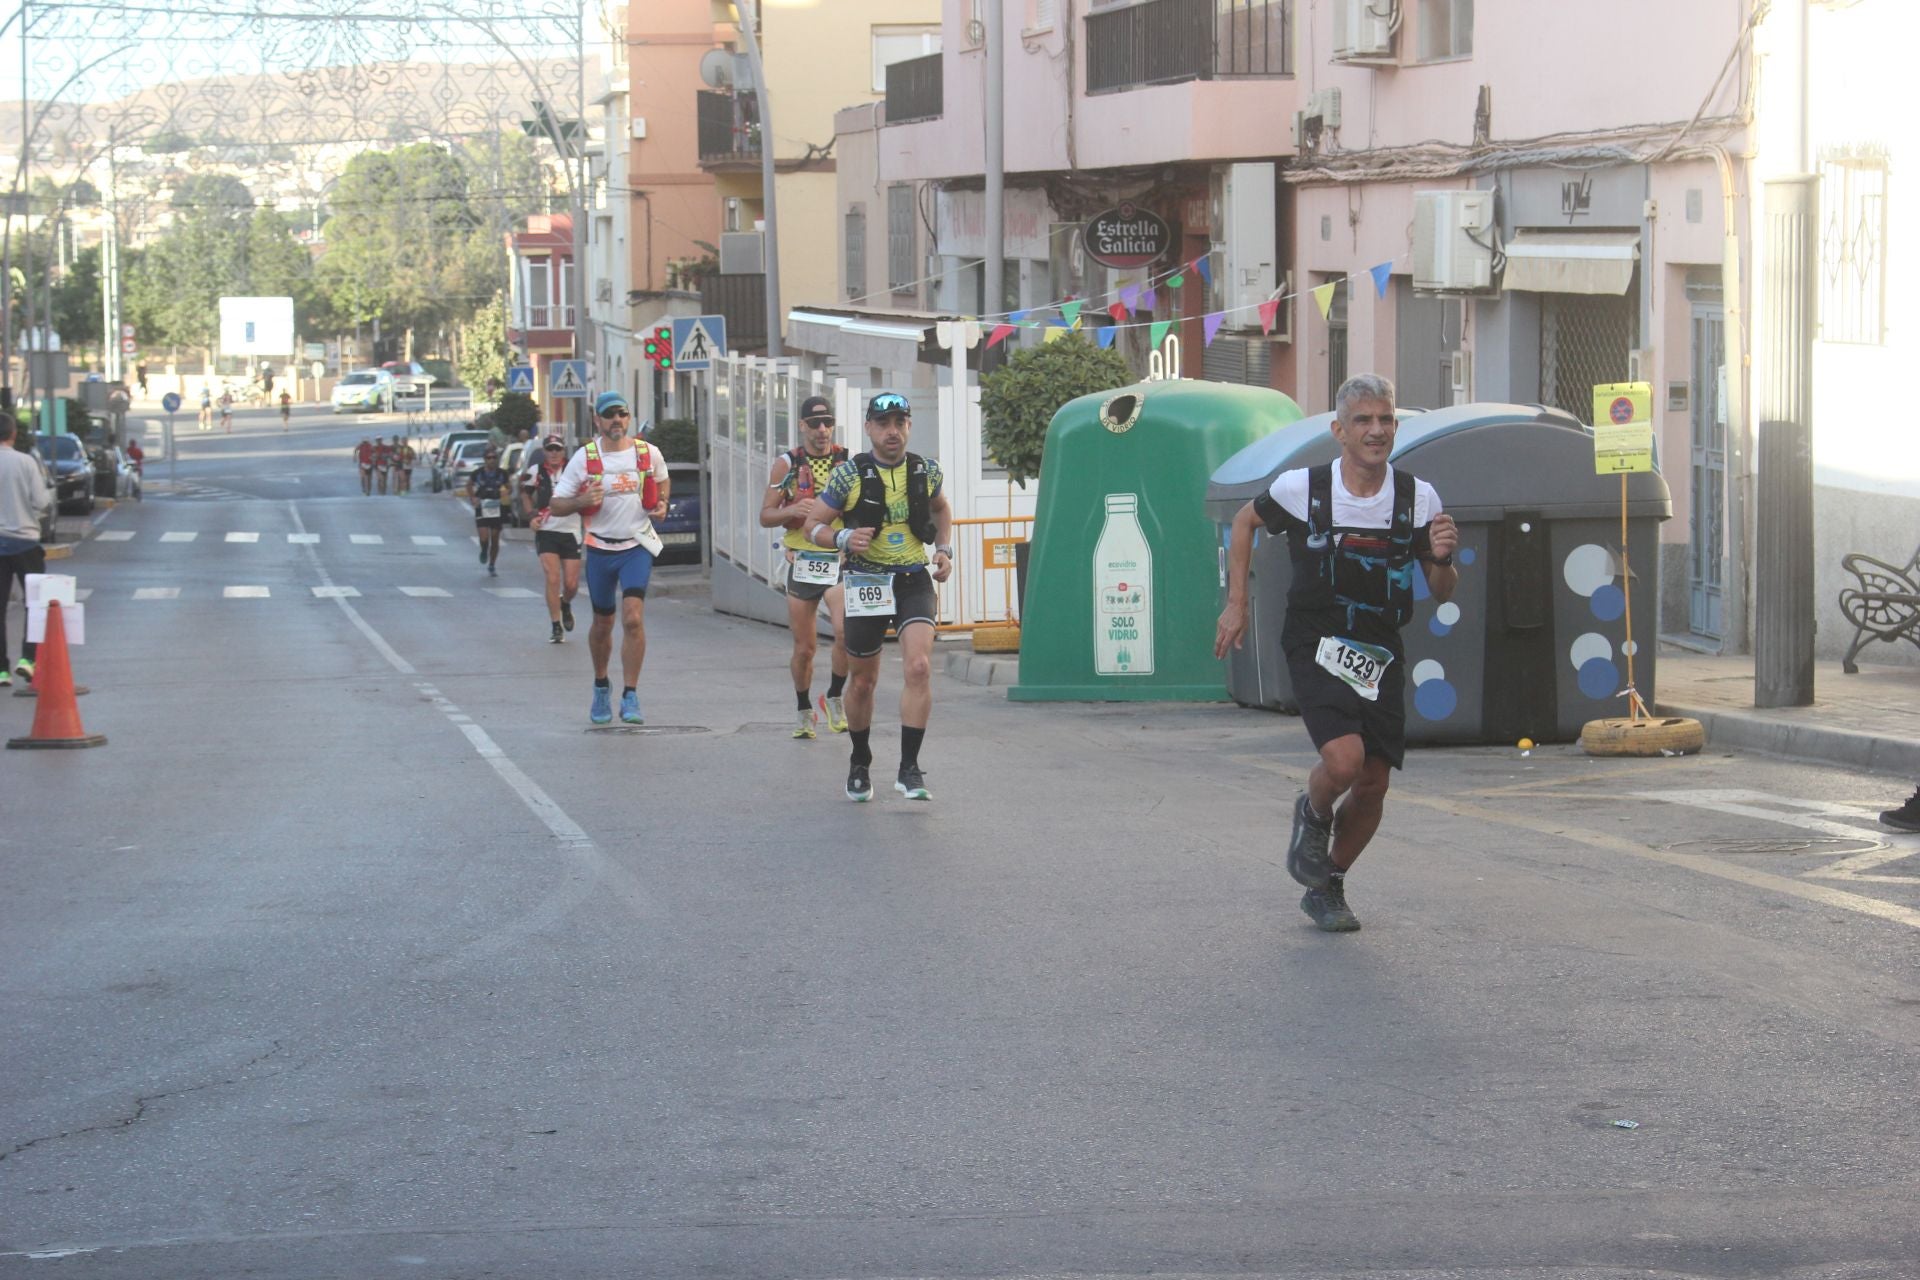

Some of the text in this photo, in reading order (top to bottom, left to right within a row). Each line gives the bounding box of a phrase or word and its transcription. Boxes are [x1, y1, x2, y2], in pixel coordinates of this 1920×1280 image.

[1096, 220, 1159, 237] Estrella
[1099, 236, 1156, 254] Galicia
[1112, 416, 1136, 432] VIDRIO
[808, 560, 830, 573] 552
[1108, 560, 1137, 569] ecovidrio
[859, 586, 882, 602] 669
[1111, 616, 1135, 628] SOLO
[1108, 629, 1138, 641] VIDRIO
[1336, 644, 1375, 680] 1529
